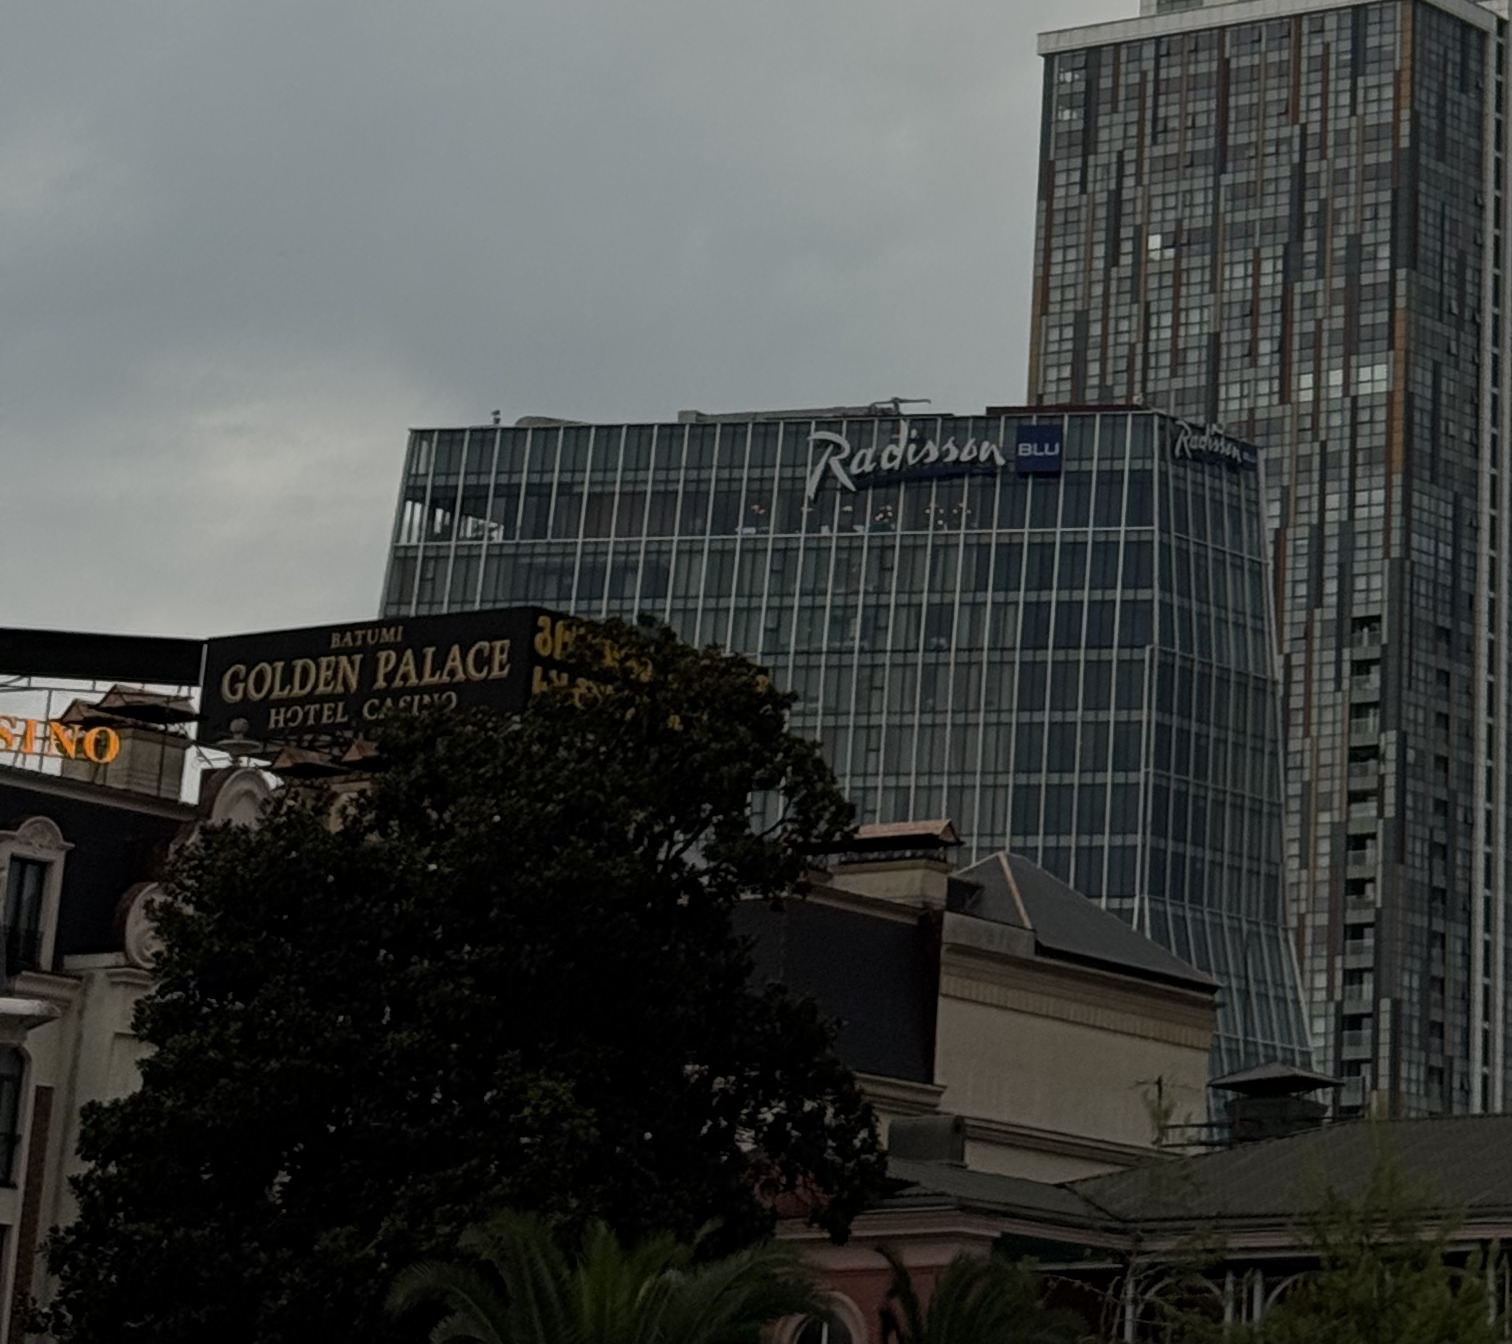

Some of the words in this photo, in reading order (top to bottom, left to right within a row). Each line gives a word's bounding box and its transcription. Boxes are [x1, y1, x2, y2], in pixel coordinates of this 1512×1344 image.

[808, 419, 1006, 502] Radisson
[1017, 441, 1060, 456] BLU
[1174, 419, 1243, 464] Radisson
[330, 624, 405, 649] BATUMI
[221, 653, 364, 704] GOLDEN
[372, 639, 512, 689] PALACE
[267, 700, 349, 729] HOTEL
